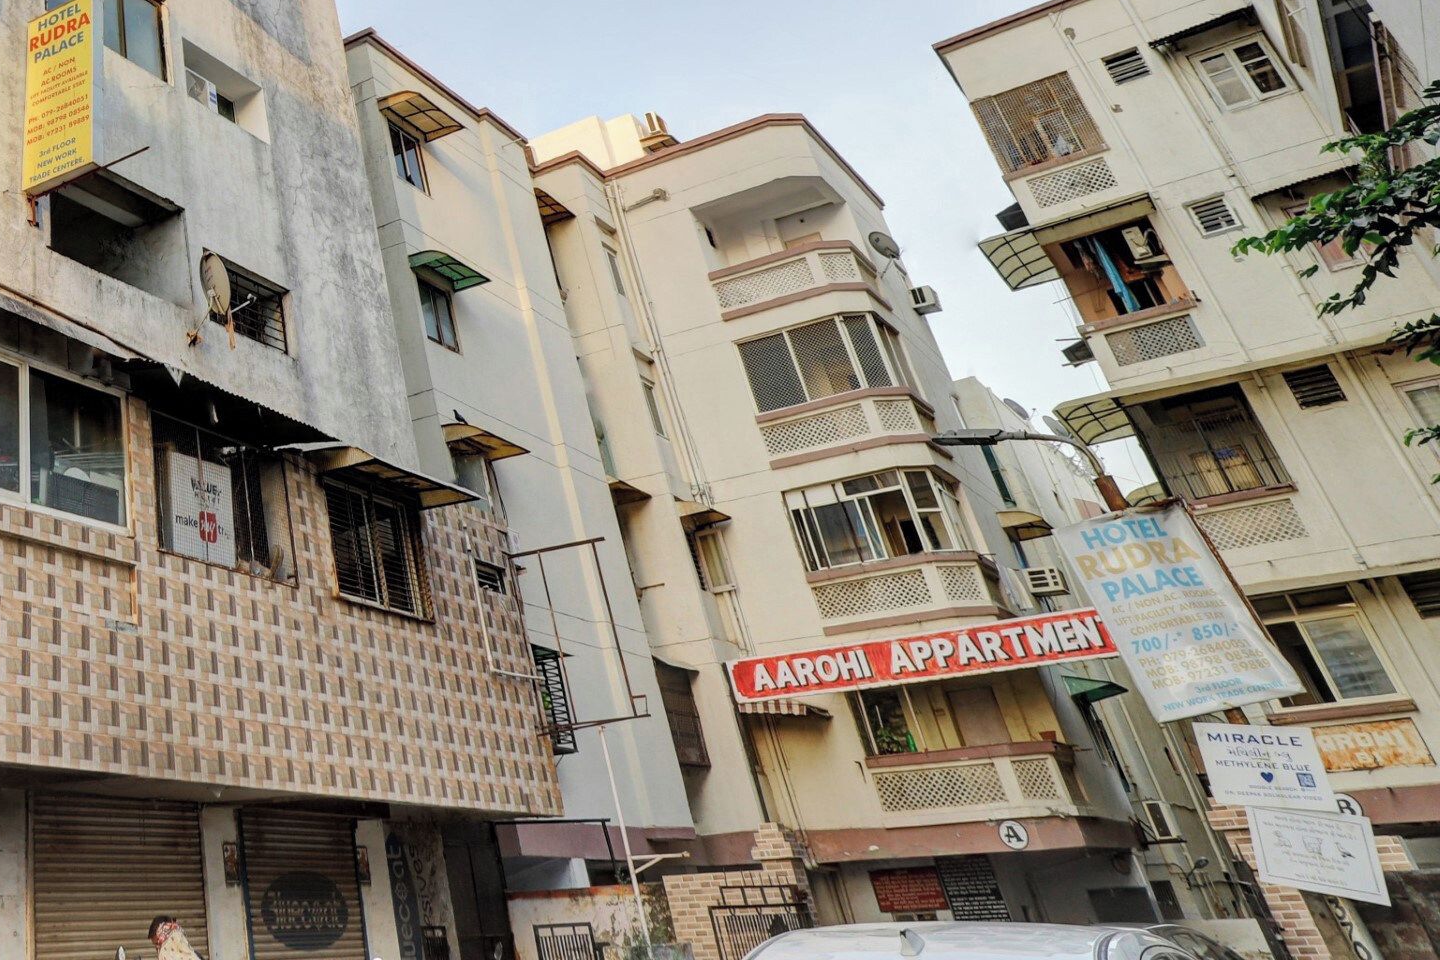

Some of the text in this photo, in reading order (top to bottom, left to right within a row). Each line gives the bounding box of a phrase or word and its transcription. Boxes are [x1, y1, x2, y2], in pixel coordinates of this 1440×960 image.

[38, 3, 81, 32] HOTEL
[29, 12, 91, 52] RUDRA
[34, 31, 84, 64] PALACE
[43, 67, 52, 76] AC
[58, 56, 76, 69] NON
[32, 85, 72, 107] COMFORTABLE
[52, 137, 77, 152] FLOOR
[37, 147, 78, 169] NEW WORK
[29, 169, 51, 184] TRADE
[175, 514, 198, 528] make
[1080, 517, 1168, 550] HOTEL
[1074, 537, 1202, 581] RUDRA
[1101, 566, 1204, 602] PALACE
[1112, 605, 1125, 614] AC
[1130, 612, 1203, 636] COMFORTABLE
[754, 615, 1104, 692] AAROHI APPARTMEN
[1145, 662, 1179, 679] MOB:
[1152, 674, 1186, 691] MOB:
[1187, 664, 1227, 682] 97231
[1195, 675, 1243, 694] 3rd FLOOR
[1163, 698, 1185, 712] NEW
[1186, 692, 1215, 708] WORK
[1216, 685, 1246, 702] TRADE
[1206, 732, 1302, 748] MIRACLE
[1215, 759, 1312, 773] METHYLENE BLUE
[1004, 825, 1025, 843] A
